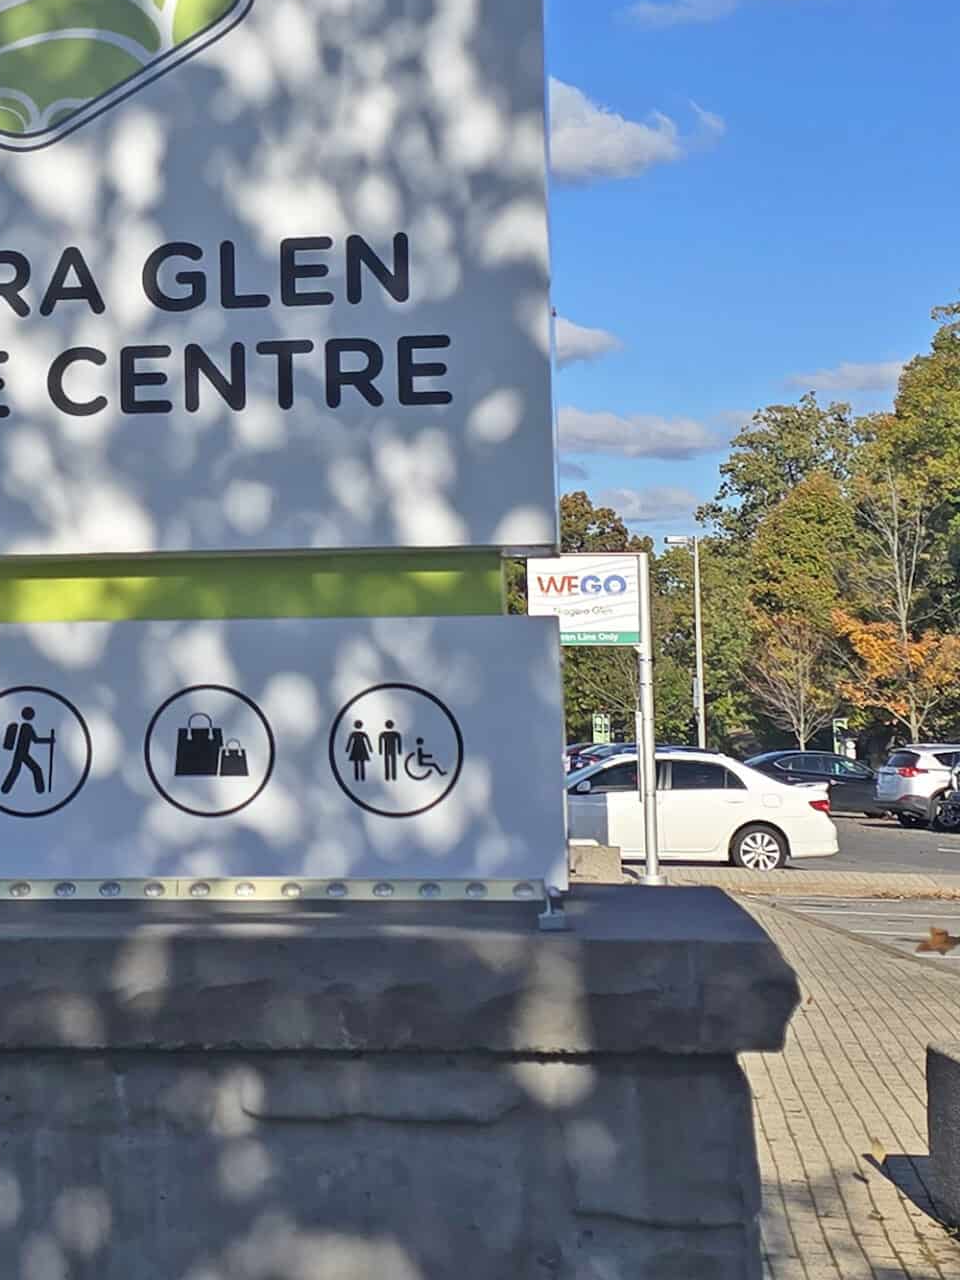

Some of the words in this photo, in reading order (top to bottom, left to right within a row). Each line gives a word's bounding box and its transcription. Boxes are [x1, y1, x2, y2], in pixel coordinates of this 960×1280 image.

[142, 231, 409, 313] GLEN
[47, 334, 454, 417] CENTRE
[536, 574, 627, 595] WEGO
[598, 633, 619, 642] Only
